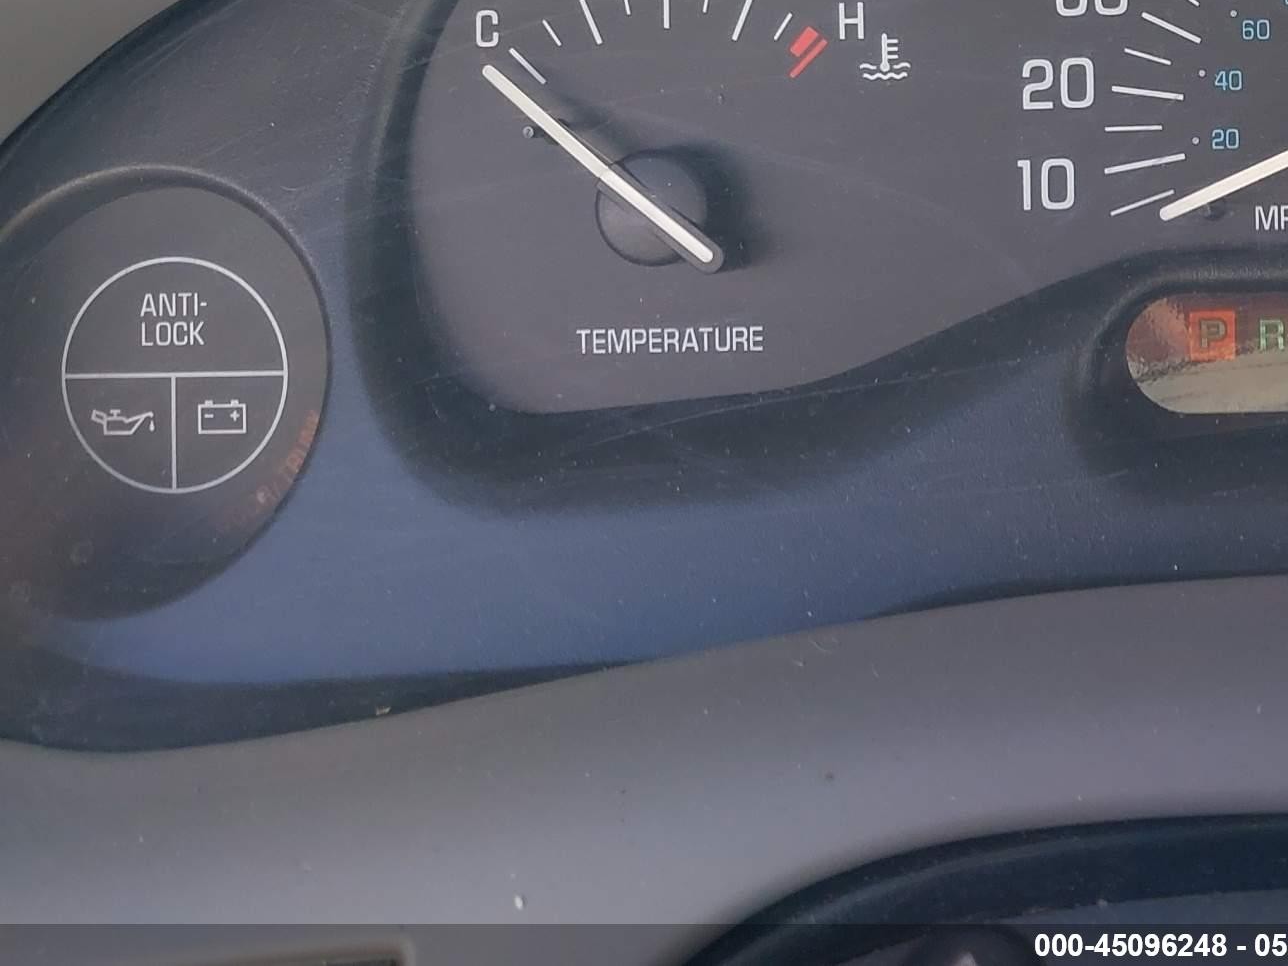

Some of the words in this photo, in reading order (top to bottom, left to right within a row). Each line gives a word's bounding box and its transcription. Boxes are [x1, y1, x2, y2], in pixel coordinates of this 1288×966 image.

[476, 10, 498, 47] C
[839, 2, 864, 39] H
[1243, 20, 1269, 39] 60
[1022, 58, 1094, 109] 20
[1215, 71, 1241, 90] 40
[1212, 129, 1240, 149] 20
[1018, 159, 1074, 210] 10
[141, 293, 207, 316] ANTI-
[142, 322, 204, 346] LOCK
[576, 327, 762, 354] TEMPERATURE
[1201, 320, 1226, 347] P
[1260, 319, 1285, 350] R
